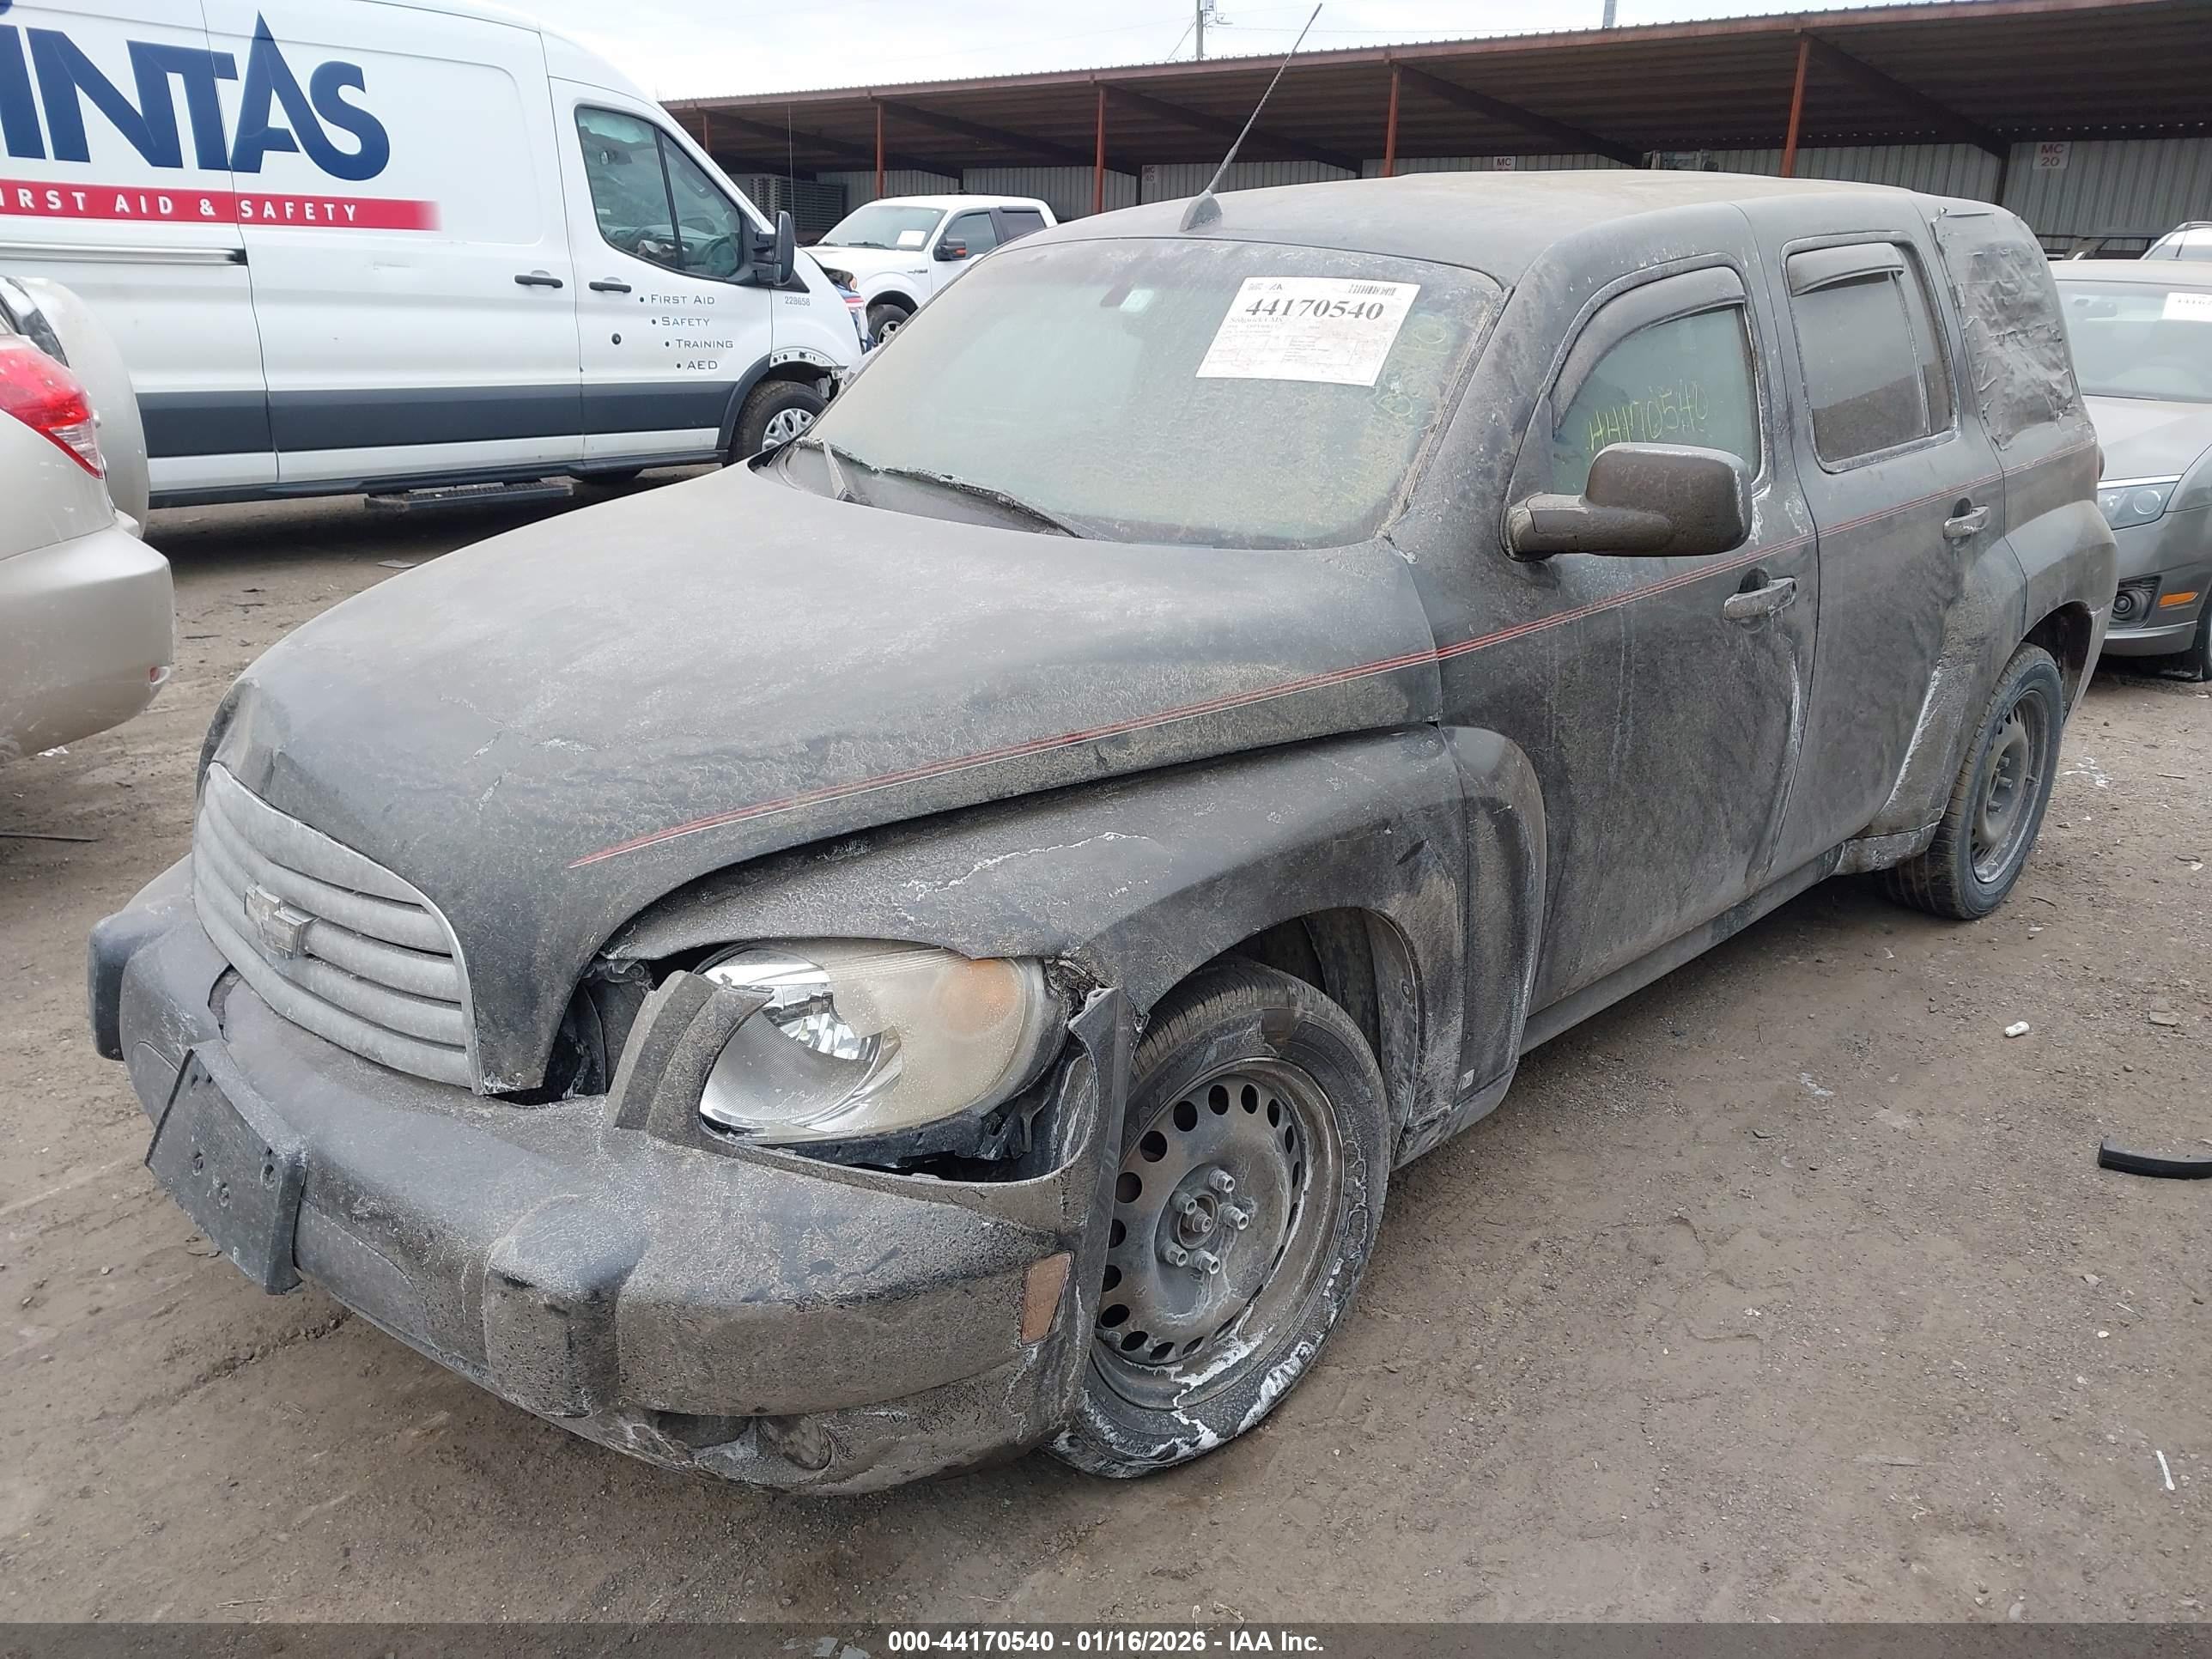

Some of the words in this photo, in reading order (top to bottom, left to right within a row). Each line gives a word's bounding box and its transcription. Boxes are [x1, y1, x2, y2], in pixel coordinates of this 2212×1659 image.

[0, 0, 391, 181] INTAS
[2040, 143, 2064, 154] MC
[1497, 157, 1512, 167] MC
[2040, 156, 2060, 167] 20
[114, 194, 173, 215] AID
[199, 198, 216, 216] &
[240, 199, 357, 222] SAFETY
[1245, 298, 1384, 320] 44170540
[686, 359, 718, 371] AED
